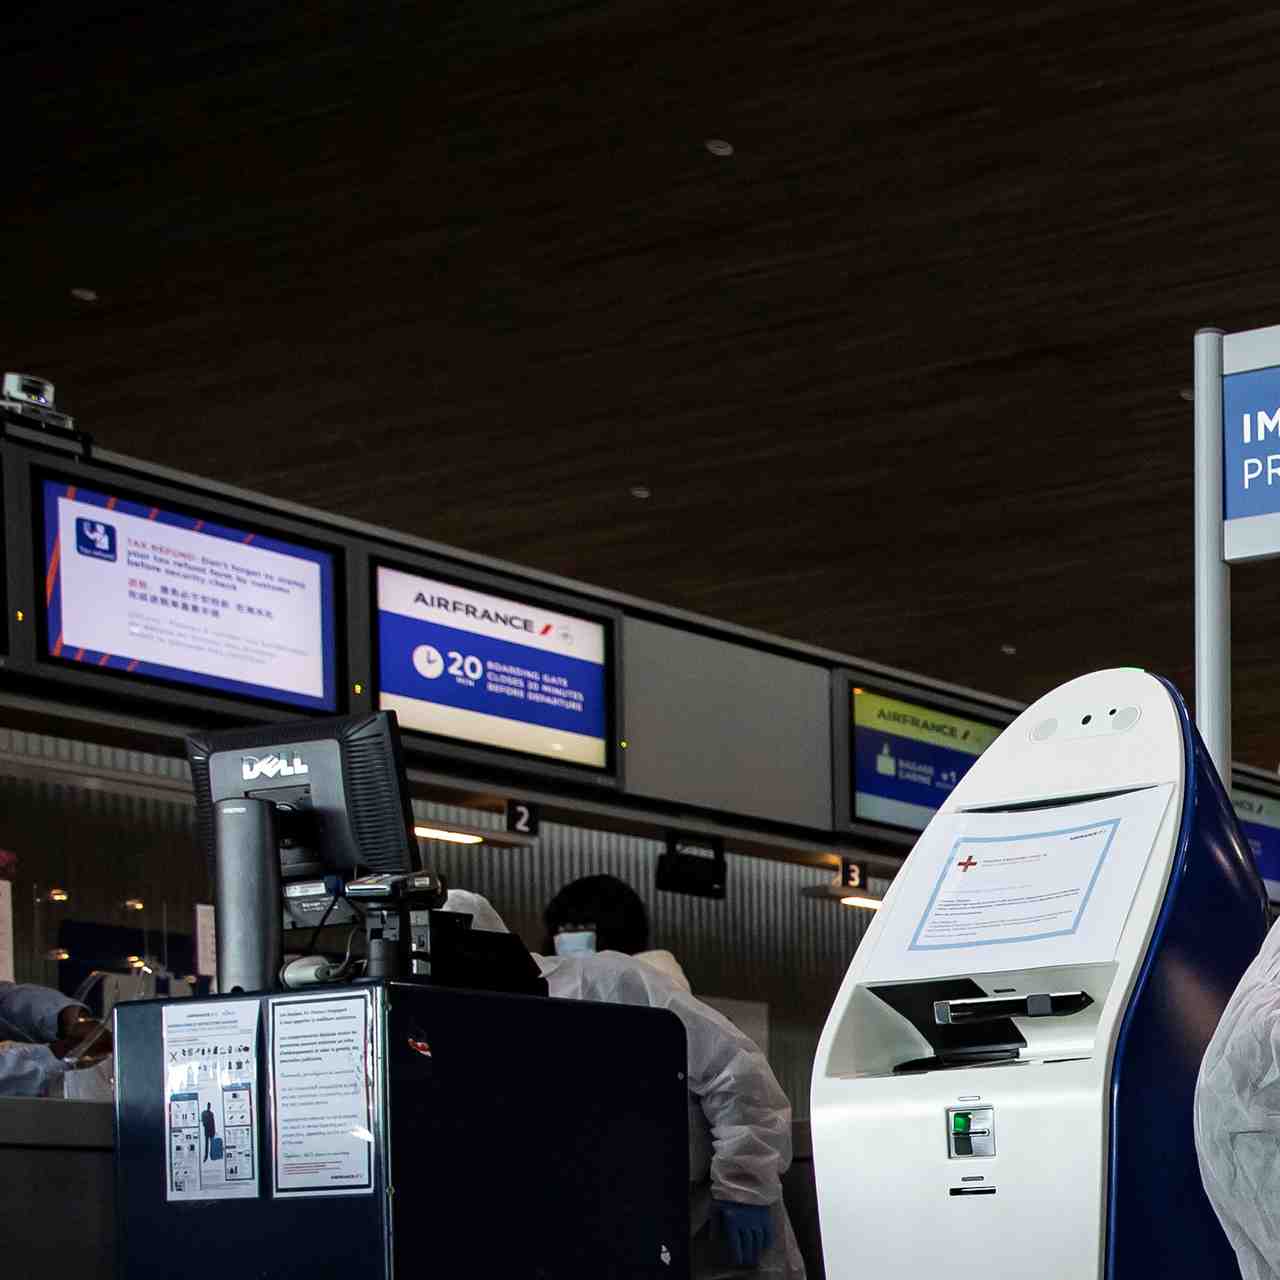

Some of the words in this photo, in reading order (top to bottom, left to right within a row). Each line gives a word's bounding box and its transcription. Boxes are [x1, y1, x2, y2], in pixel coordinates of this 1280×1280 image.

[413, 592, 534, 634] AIRFRANCE
[447, 651, 484, 681] 20
[877, 707, 958, 738] AIRFRANCE
[241, 752, 309, 780] DELL
[515, 805, 530, 833] 2
[848, 863, 861, 888] 3
